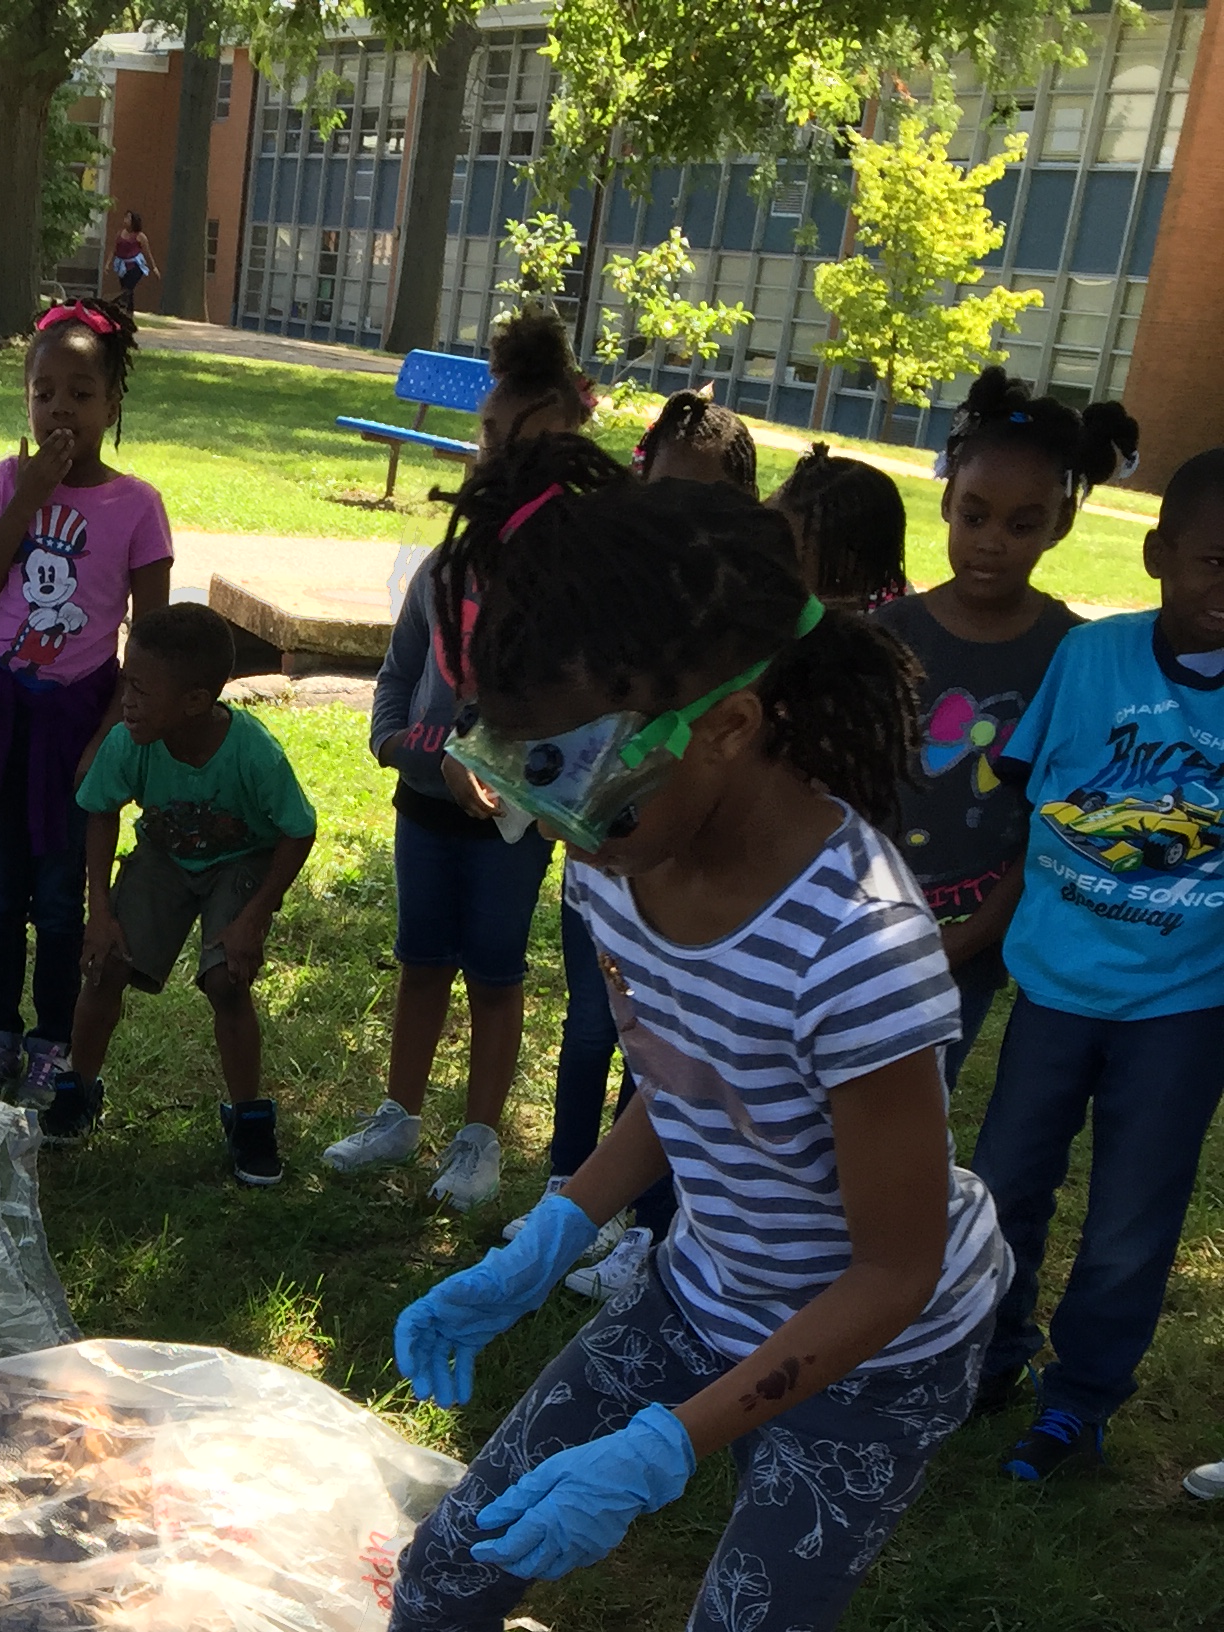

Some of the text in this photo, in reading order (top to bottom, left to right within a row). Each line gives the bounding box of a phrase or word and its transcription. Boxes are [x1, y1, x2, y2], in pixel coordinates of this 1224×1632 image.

[1038, 854, 1224, 908] SUPER SONIC
[1060, 882, 1183, 936] Speedway
